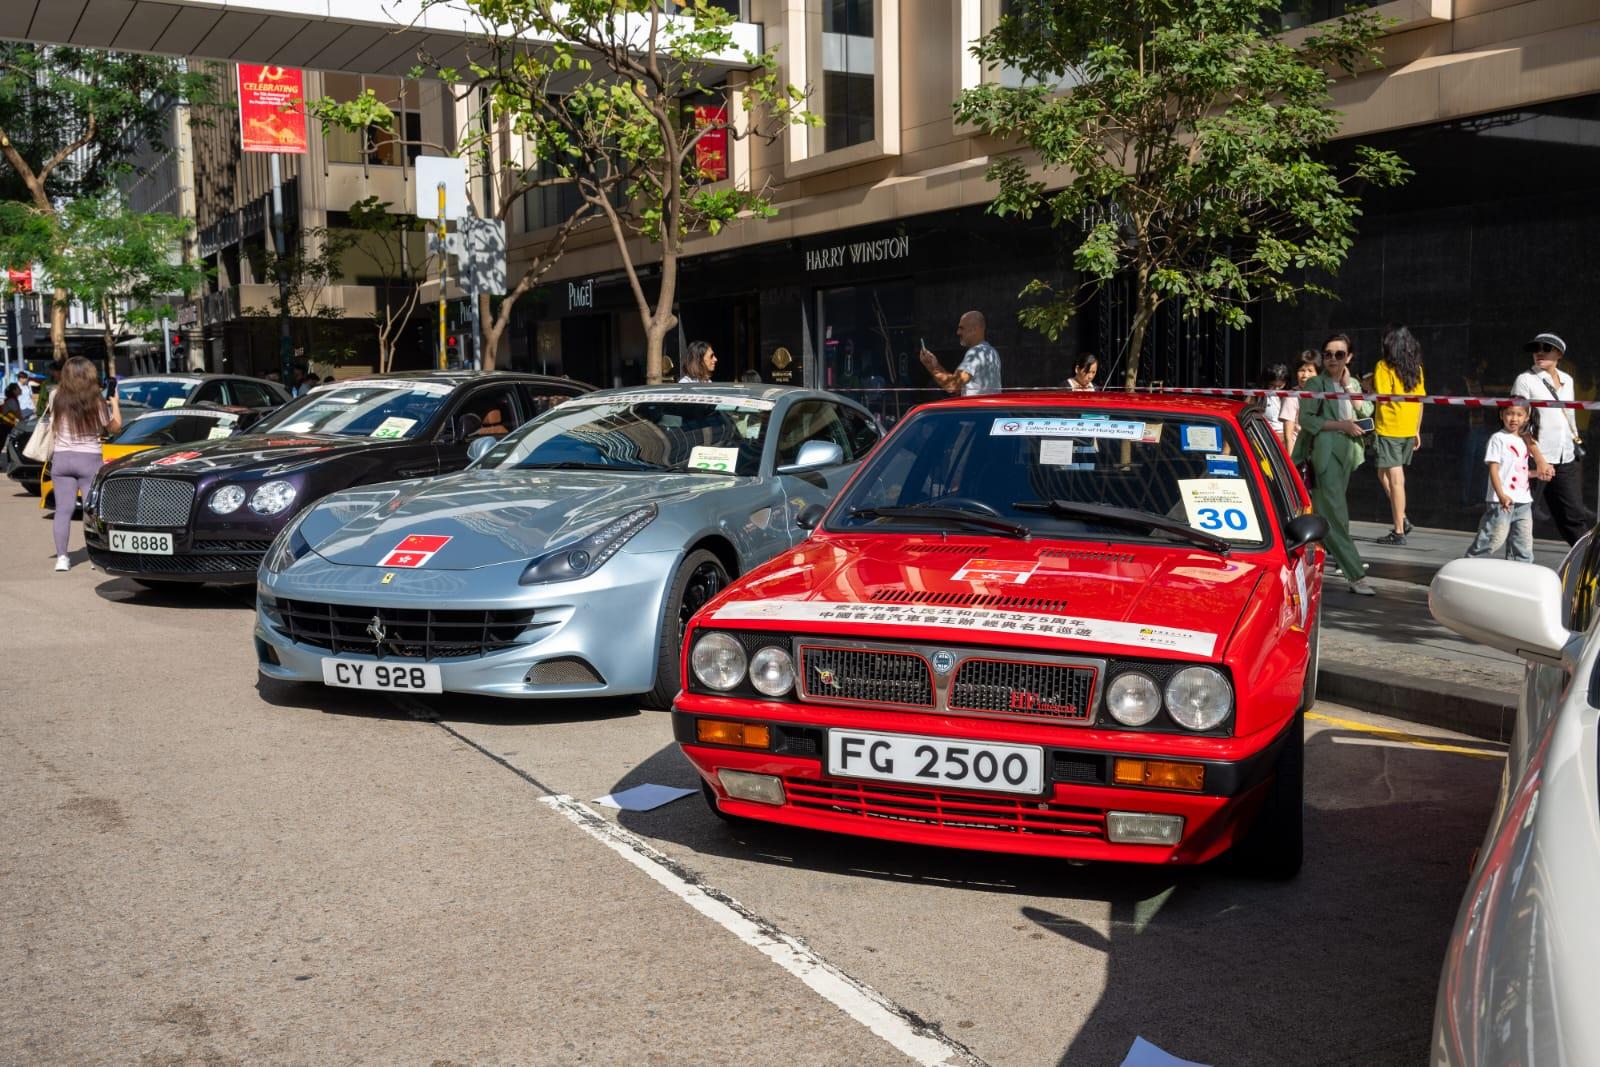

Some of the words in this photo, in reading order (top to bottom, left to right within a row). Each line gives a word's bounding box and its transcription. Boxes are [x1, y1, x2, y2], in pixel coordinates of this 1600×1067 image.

[243, 82, 299, 94] CELEBRATING
[806, 245, 846, 271] HARRY
[849, 235, 909, 263] WINSTON
[568, 279, 594, 310] PIAGET
[1197, 508, 1248, 531] 30
[112, 534, 127, 549] CY
[131, 535, 169, 552] 8888
[335, 663, 364, 685] CY
[375, 666, 426, 688] 928
[841, 737, 894, 774] FG
[914, 744, 1028, 786] 2500
